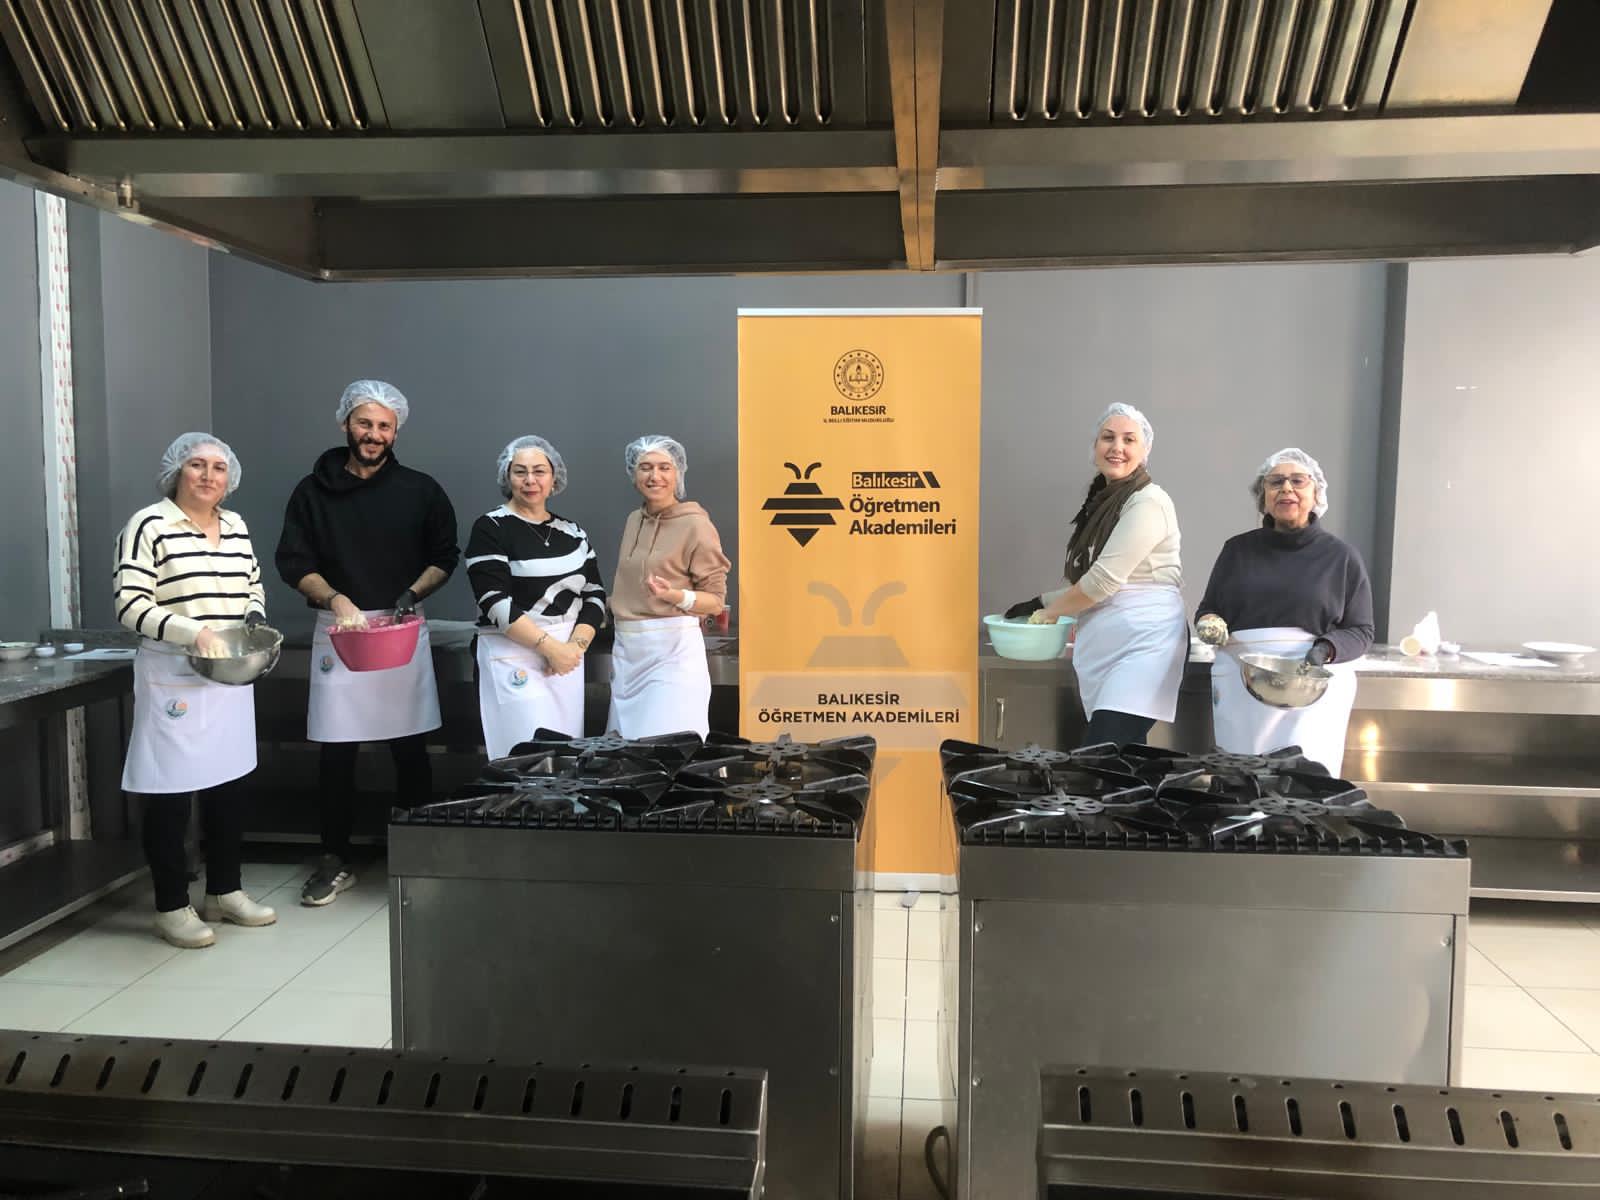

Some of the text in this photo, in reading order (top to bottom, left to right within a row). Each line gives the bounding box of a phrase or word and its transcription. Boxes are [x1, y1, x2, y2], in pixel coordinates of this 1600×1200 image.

[852, 473, 919, 488] Balıkesir
[849, 494, 940, 517] Öğretmen
[849, 518, 957, 535] Akademileri
[817, 691, 900, 705] BALIKESİR
[758, 708, 960, 723] ÖĞRETMEN AKADEMİLERİ
